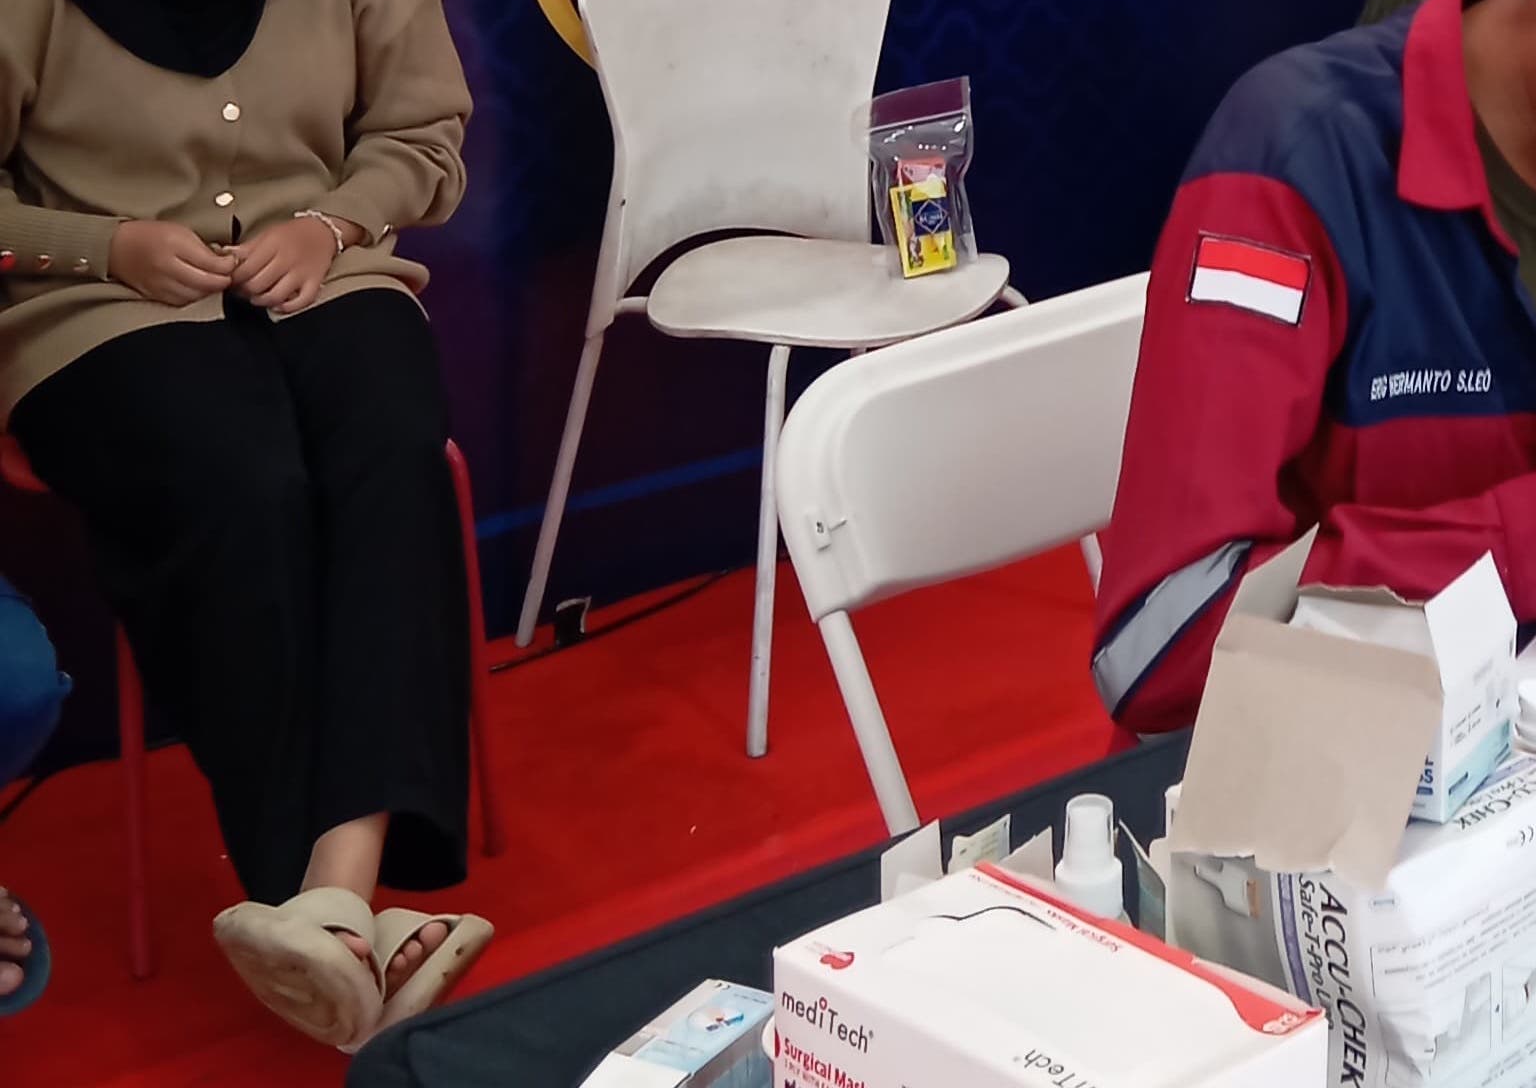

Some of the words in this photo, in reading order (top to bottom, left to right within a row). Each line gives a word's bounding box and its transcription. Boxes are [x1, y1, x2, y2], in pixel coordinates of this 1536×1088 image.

[1319, 881, 1368, 1088] ACCU-CHEK
[780, 990, 870, 1053] mediTech
[783, 1037, 832, 1081] Surgical
